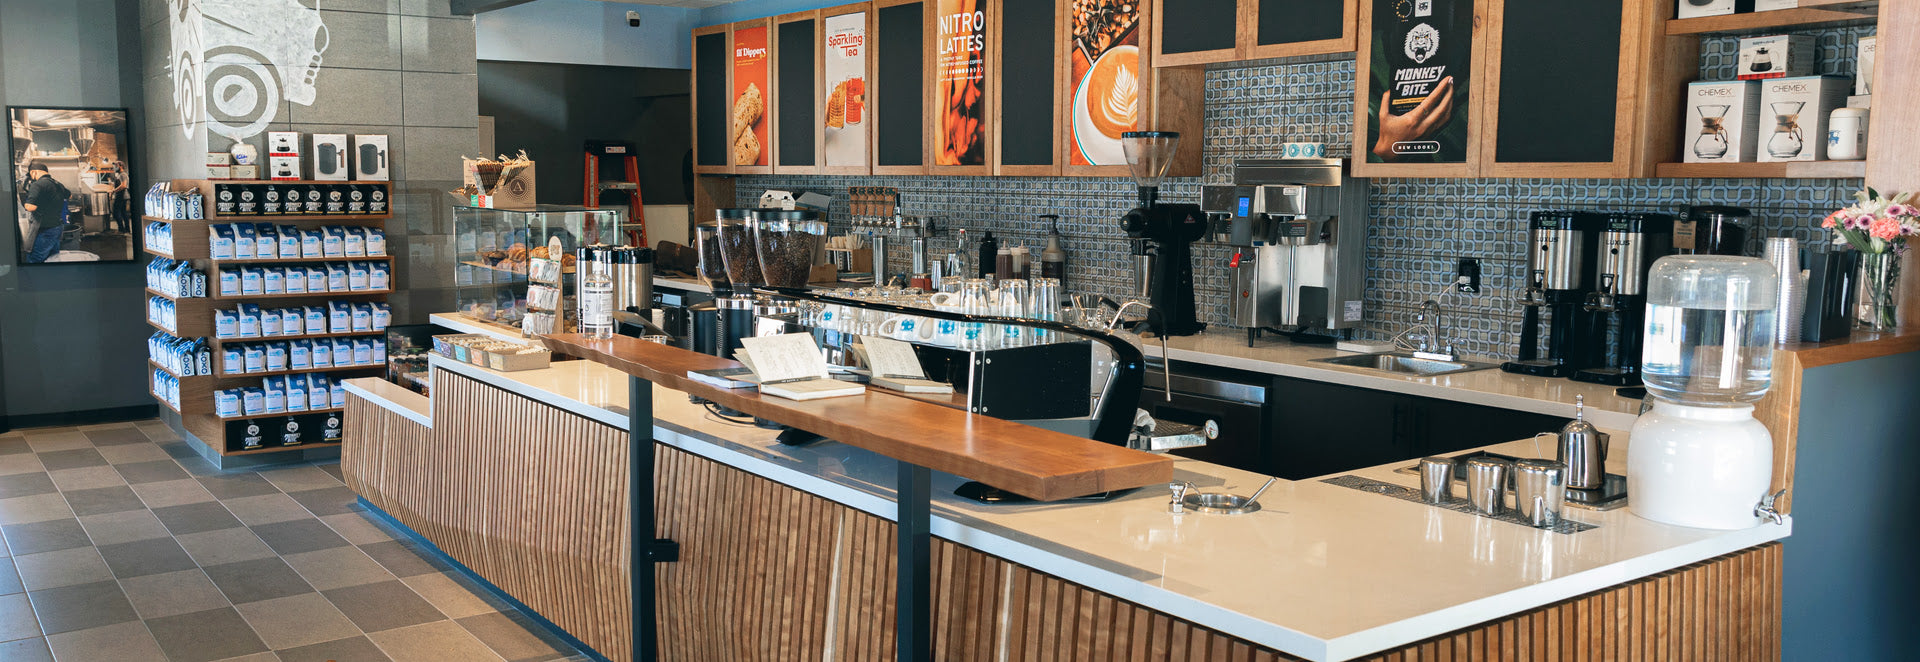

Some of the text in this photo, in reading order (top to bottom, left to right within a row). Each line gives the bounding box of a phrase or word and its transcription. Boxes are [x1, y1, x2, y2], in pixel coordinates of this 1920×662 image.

[940, 11, 984, 35] NITRO
[828, 32, 863, 49] Sparkling
[940, 34, 984, 55] LATTES
[840, 45, 858, 57] Tea
[1394, 65, 1446, 81] MONKEY
[1401, 83, 1430, 96] BITE
[1698, 88, 1732, 97] CHEMEX
[1772, 84, 1807, 93] CHEMEX
